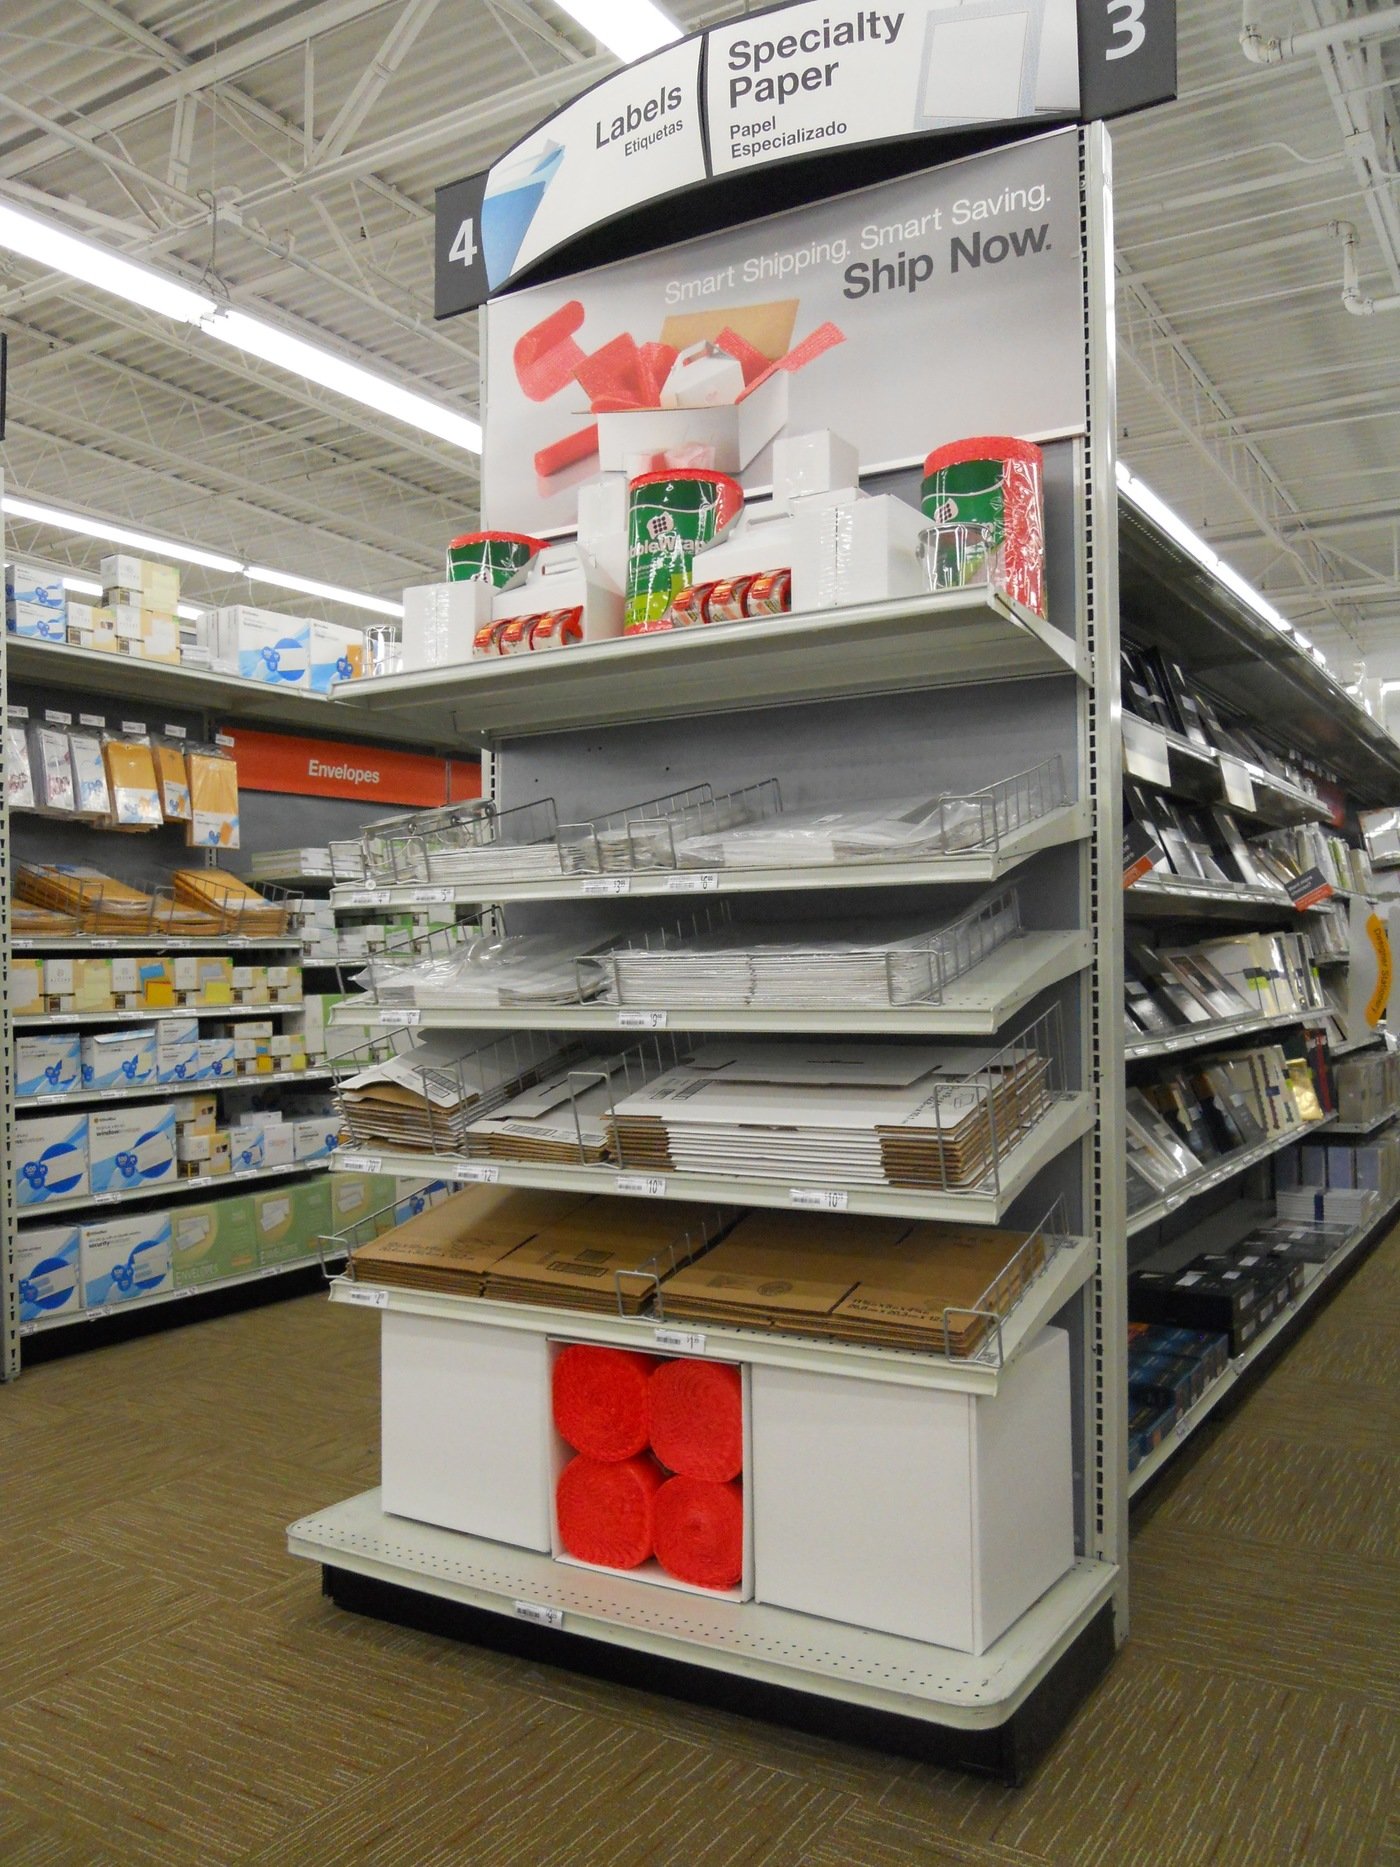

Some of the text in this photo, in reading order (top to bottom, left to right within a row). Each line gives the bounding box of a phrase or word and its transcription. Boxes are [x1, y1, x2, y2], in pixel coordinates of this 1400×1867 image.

[728, 11, 905, 72] Specialty
[1105, 0, 1146, 60] 3
[729, 61, 839, 109] Paper
[596, 86, 682, 149] Labels
[625, 119, 683, 156] Etiquetas
[730, 116, 776, 140] Papel
[731, 121, 848, 158] Especializado
[449, 218, 478, 267] 4
[665, 184, 1052, 304] Smart Shipping. Smart Saving.
[843, 224, 1052, 299] Ship Now.
[308, 759, 380, 784] Envelopes
